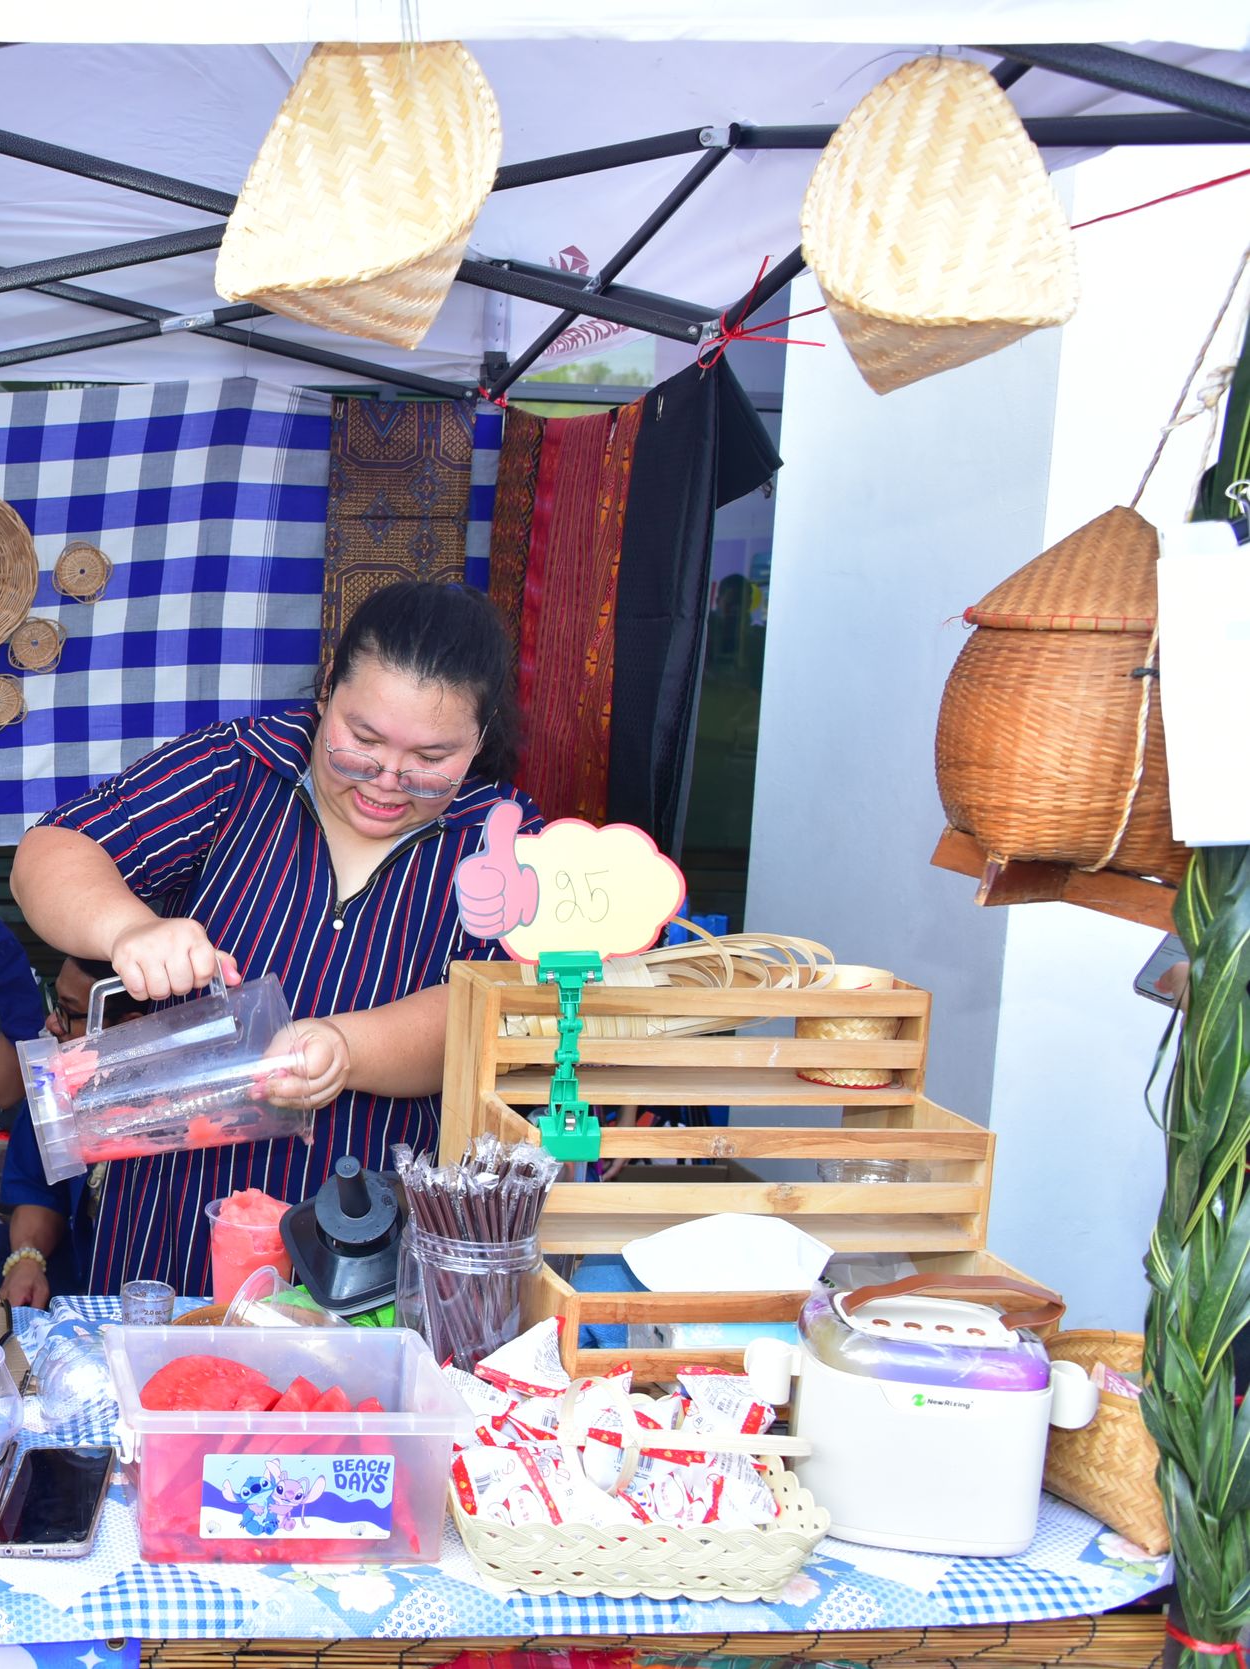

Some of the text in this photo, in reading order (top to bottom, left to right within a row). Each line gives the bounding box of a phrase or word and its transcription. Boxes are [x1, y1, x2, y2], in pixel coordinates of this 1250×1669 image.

[554, 868, 610, 923] 25
[927, 1398, 971, 1410] NewRising
[332, 1458, 391, 1475] BEACH
[334, 1471, 389, 1494] DAYS
